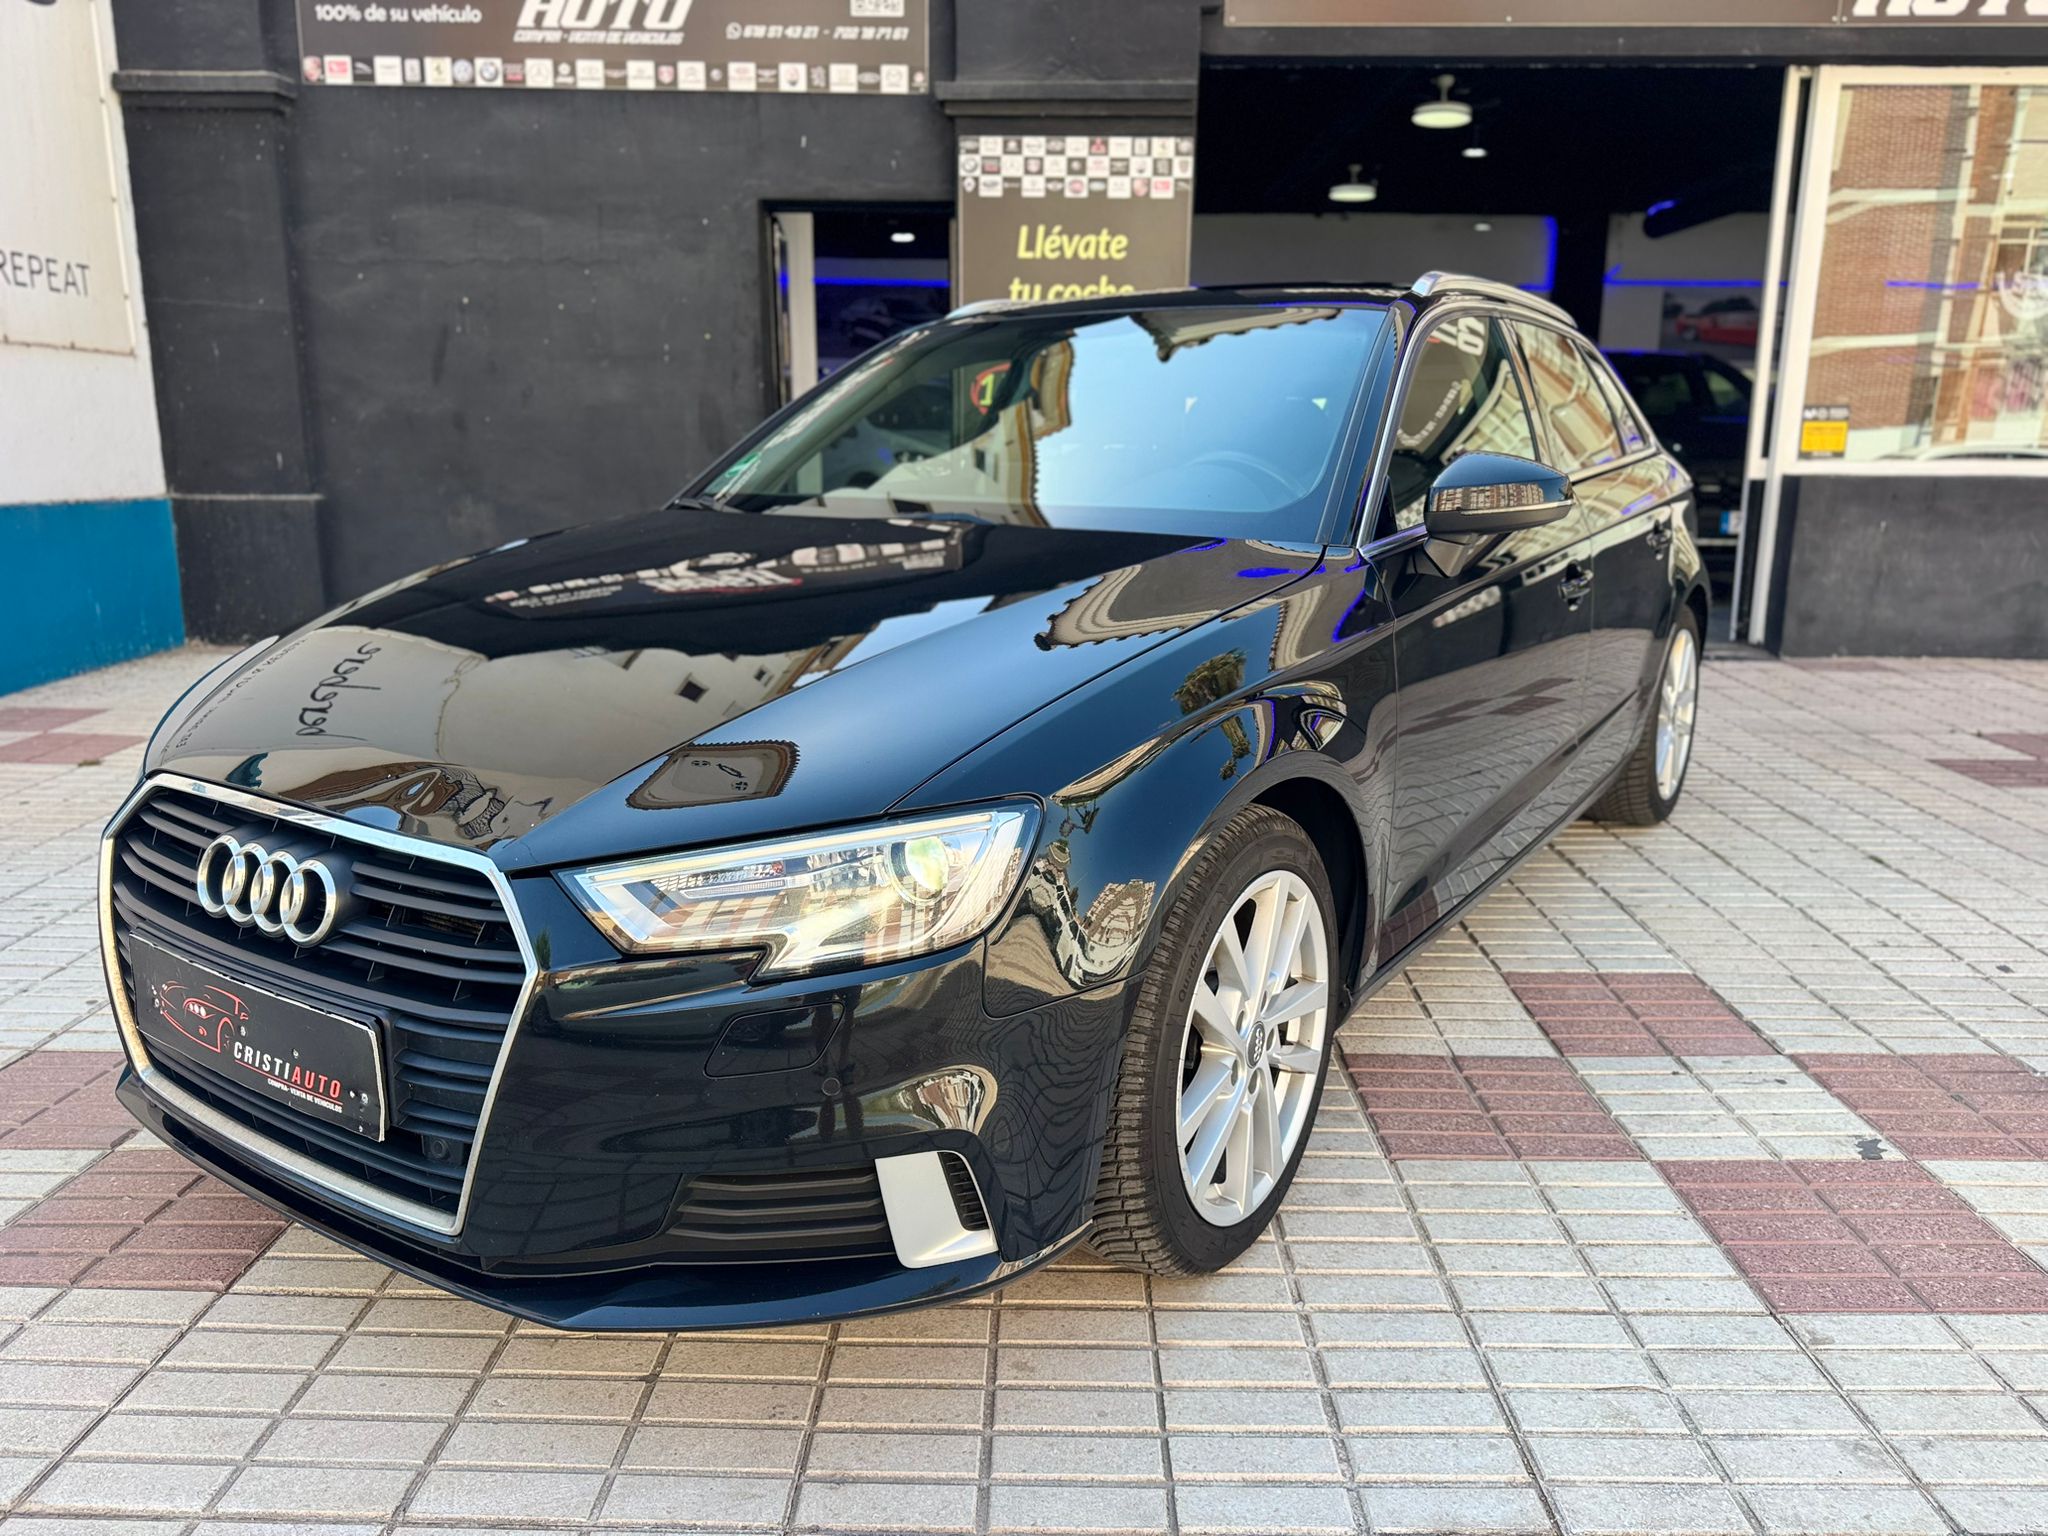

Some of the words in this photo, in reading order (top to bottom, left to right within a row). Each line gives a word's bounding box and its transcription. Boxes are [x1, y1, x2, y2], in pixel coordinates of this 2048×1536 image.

[315, 4, 361, 22] 100%
[364, 3, 387, 22] de
[390, 7, 409, 22] su
[412, 3, 482, 23] vehículo
[516, 0, 693, 30] AUTO
[1017, 223, 1129, 260] Llévate
[1009, 277, 1042, 304] tu
[233, 1041, 341, 1098] CRISTIAUTO
